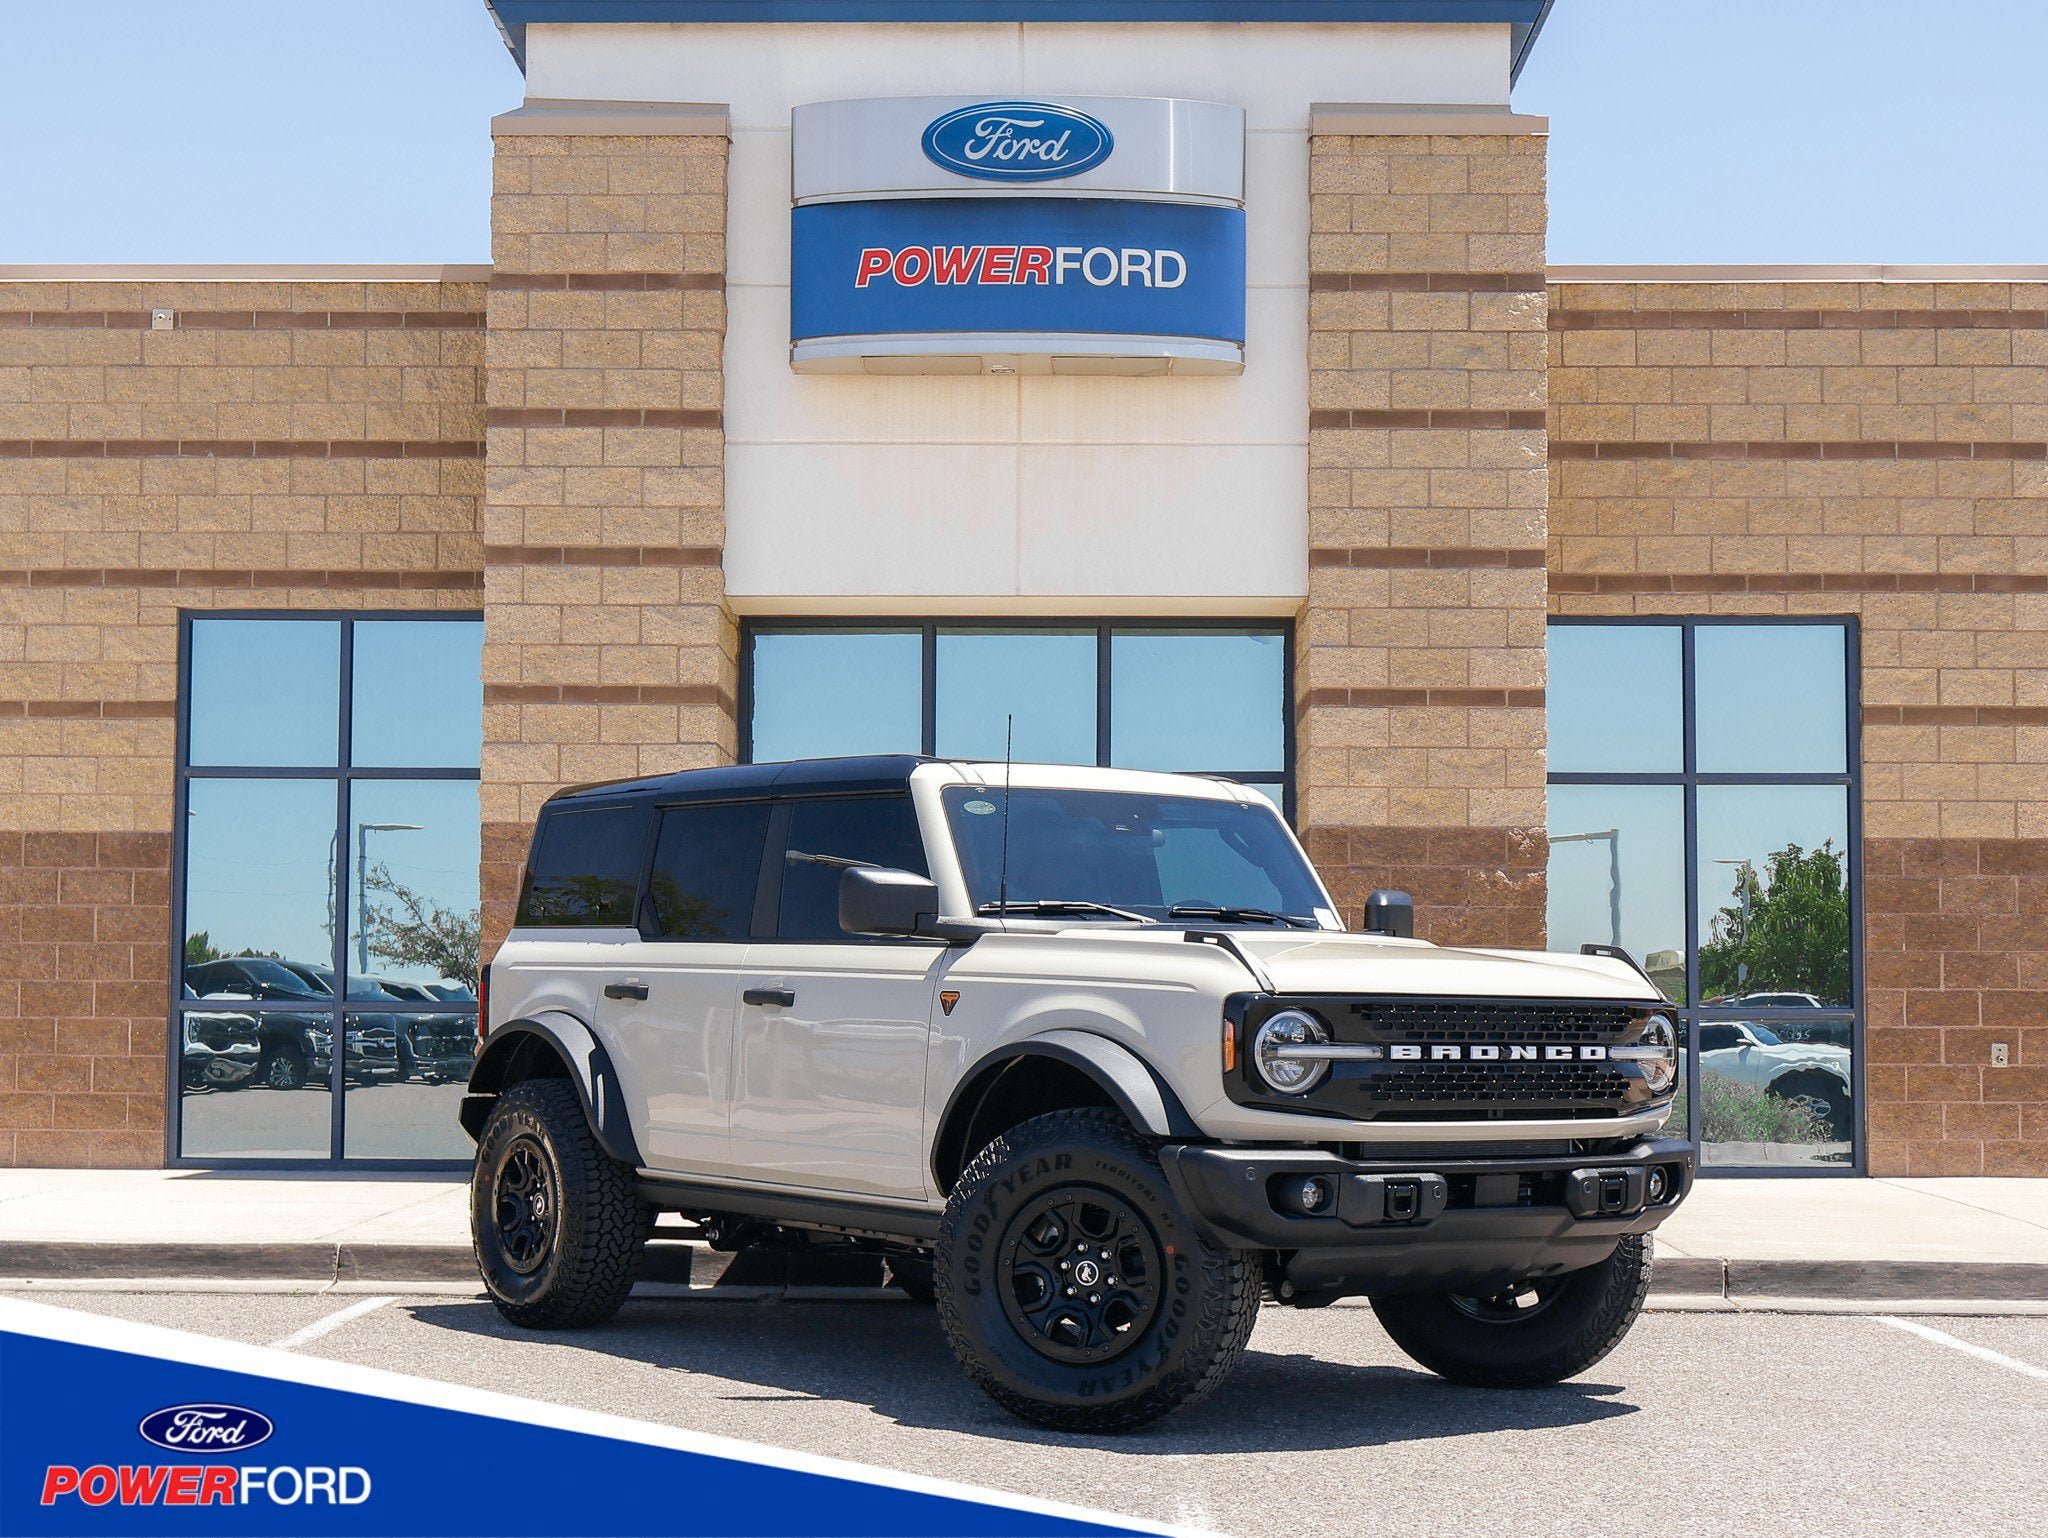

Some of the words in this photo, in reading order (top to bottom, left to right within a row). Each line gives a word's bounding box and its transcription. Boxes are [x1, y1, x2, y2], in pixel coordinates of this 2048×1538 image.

[964, 117, 1071, 163] Ford
[1390, 1044, 1606, 1061] BRONCO
[1095, 1159, 1159, 1203] TERRITORY
